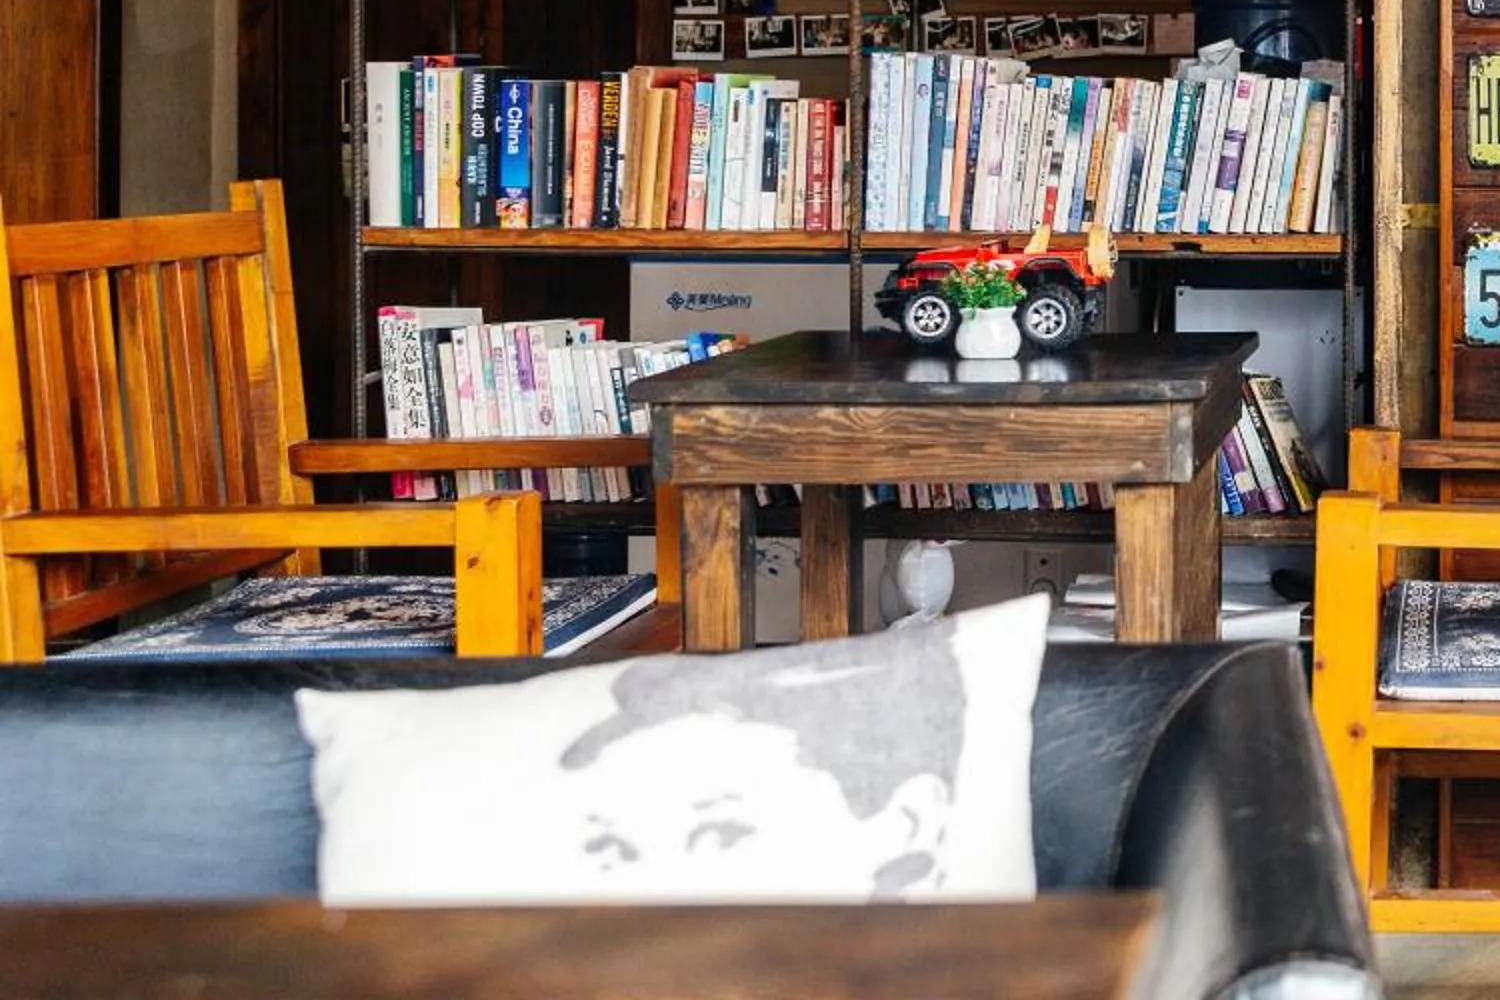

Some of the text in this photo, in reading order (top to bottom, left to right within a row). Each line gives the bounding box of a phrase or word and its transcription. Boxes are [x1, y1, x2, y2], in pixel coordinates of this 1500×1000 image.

[471, 72, 487, 138] COP TOWN
[506, 106, 523, 155] China
